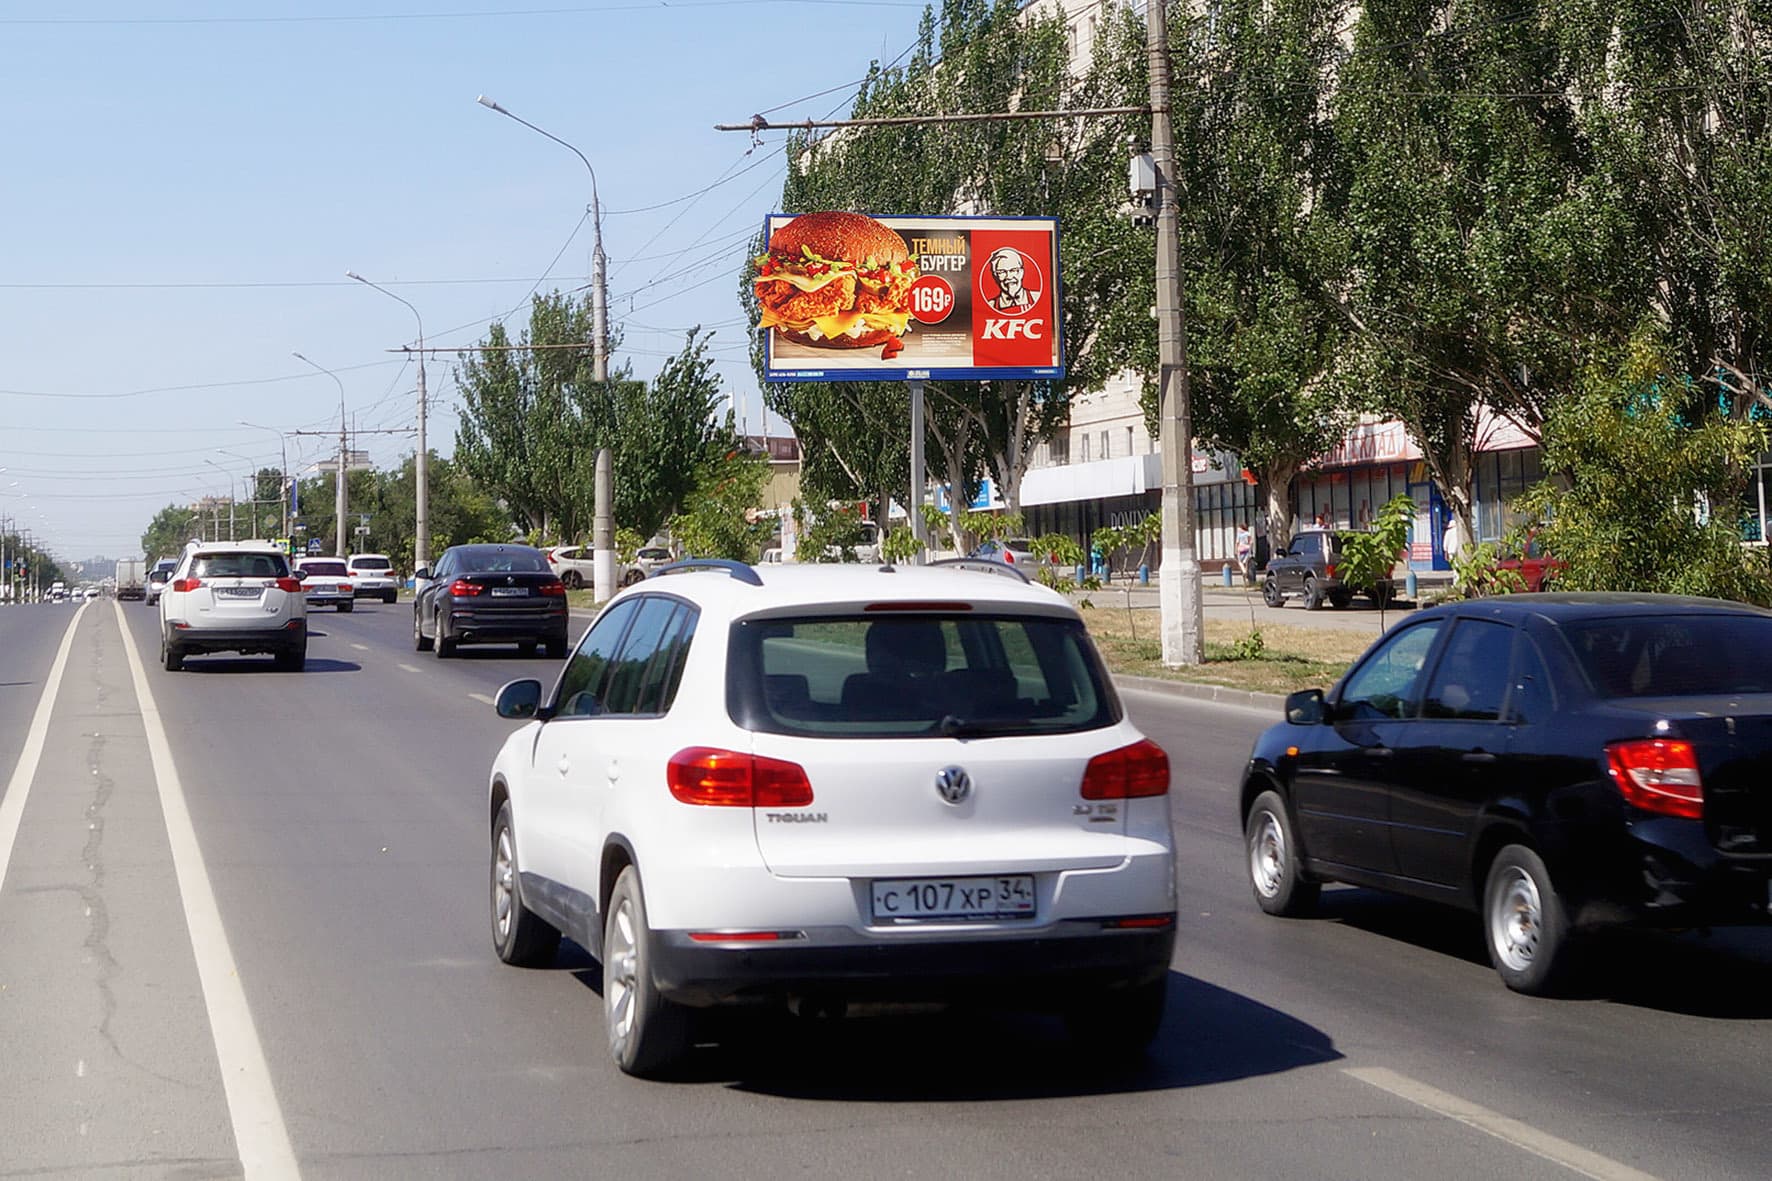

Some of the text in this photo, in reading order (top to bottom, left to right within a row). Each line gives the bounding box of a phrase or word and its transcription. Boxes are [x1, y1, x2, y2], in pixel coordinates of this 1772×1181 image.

[911, 234, 966, 255] ТЕМНЫЙ
[920, 254, 966, 272] БУРГЕР
[980, 318, 1044, 341] KFC
[766, 813, 828, 823] TIGUAN
